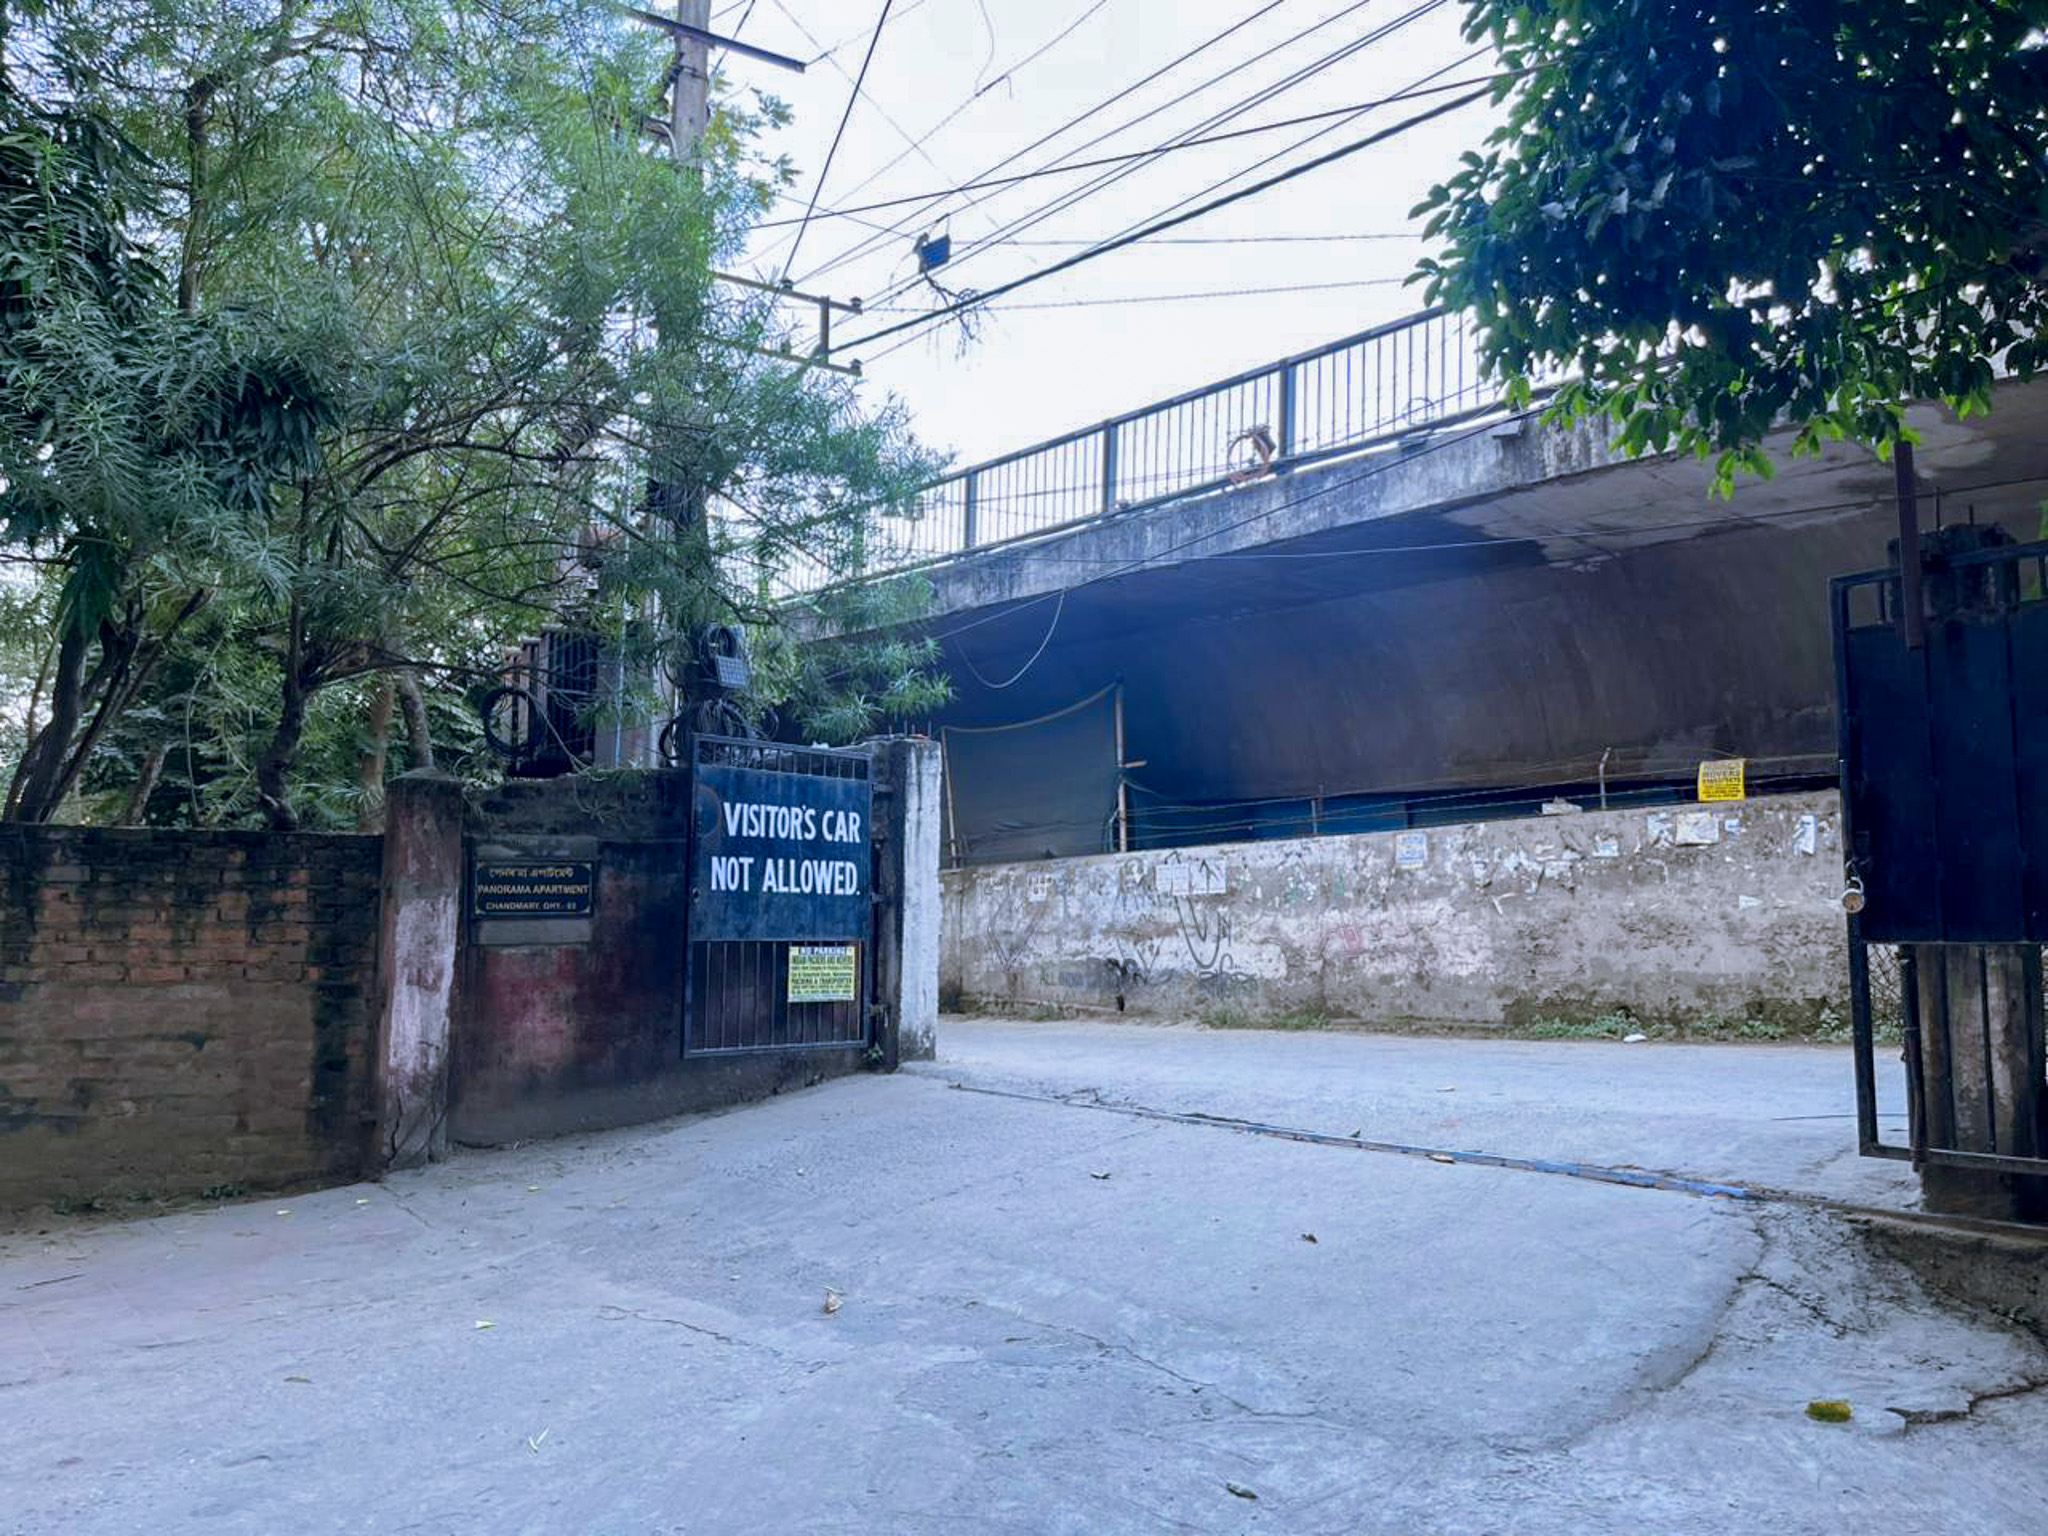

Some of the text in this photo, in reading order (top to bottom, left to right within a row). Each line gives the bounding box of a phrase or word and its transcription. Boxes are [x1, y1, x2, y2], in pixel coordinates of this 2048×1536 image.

[723, 802, 861, 843] VISITOR'S CAR
[477, 884, 589, 894] PANORAMA APARTMENT
[711, 856, 861, 896] NOT ALLOWED.
